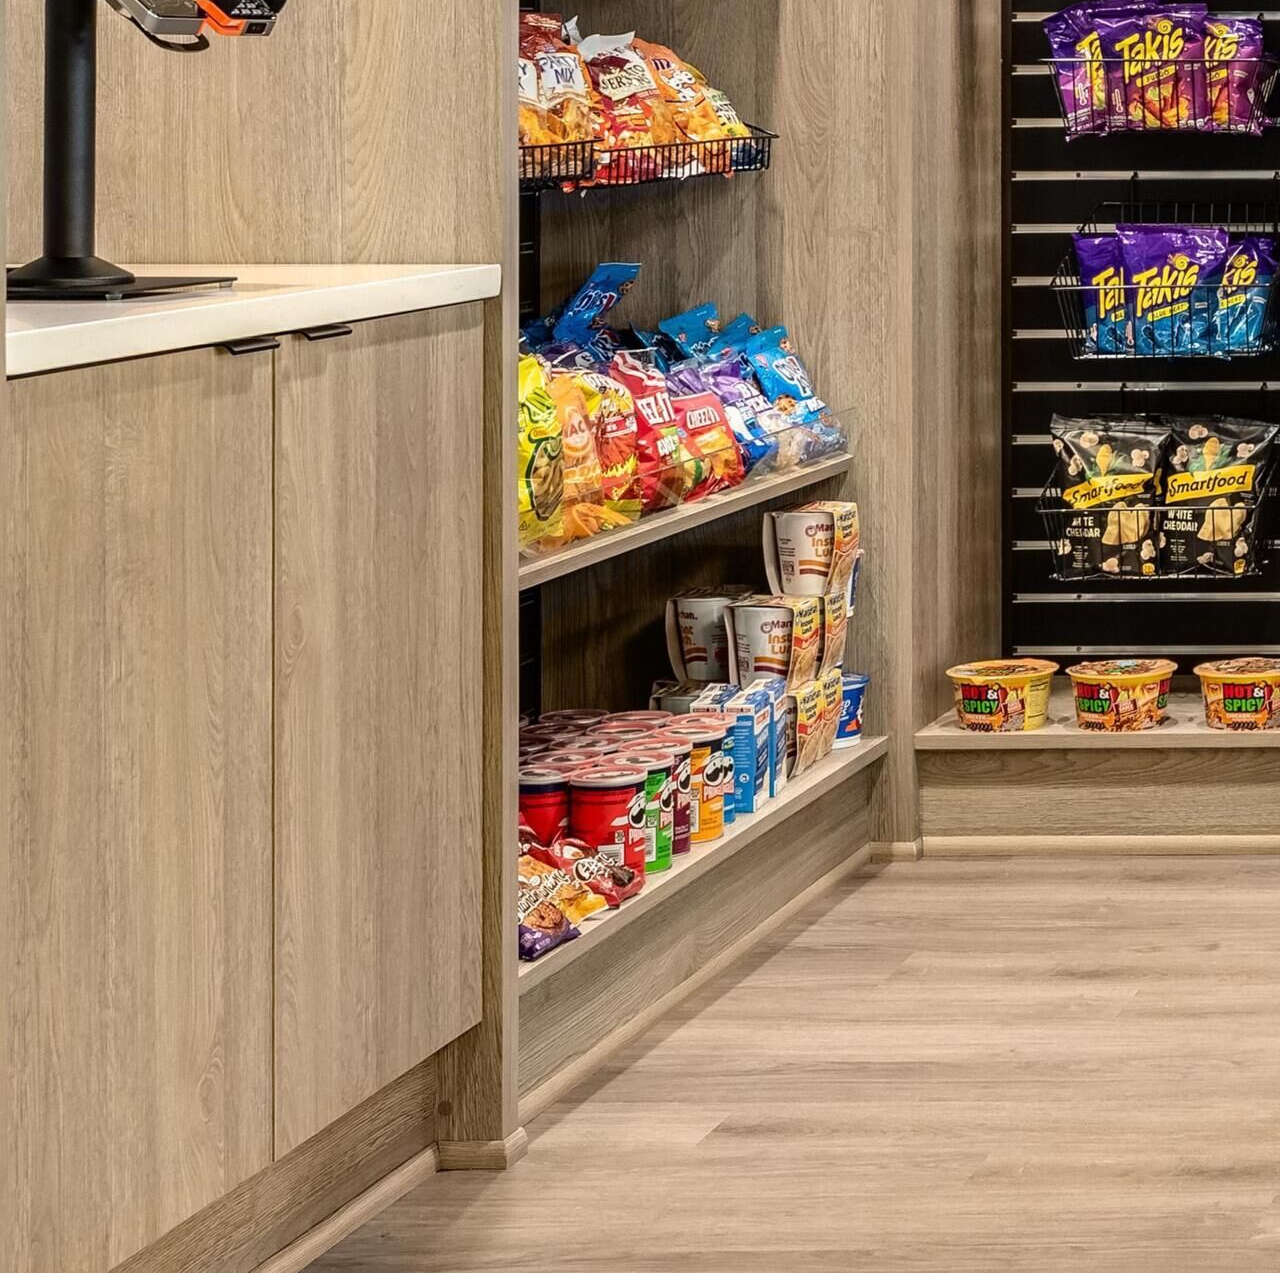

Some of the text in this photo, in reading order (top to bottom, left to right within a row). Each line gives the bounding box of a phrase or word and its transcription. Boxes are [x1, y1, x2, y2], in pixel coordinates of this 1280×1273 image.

[1116, 24, 1184, 83] Takis
[554, 67, 576, 85] MIX
[1132, 261, 1199, 318] Takis
[1169, 471, 1248, 496] Smartfood
[1071, 479, 1145, 506] Smartfood
[962, 683, 998, 700] HOT &
[1077, 682, 1110, 699] HOT &
[1223, 683, 1264, 699] HOT &
[963, 699, 998, 714] SPICY
[1078, 698, 1111, 713] SPICY
[1224, 698, 1264, 712] SPICY
